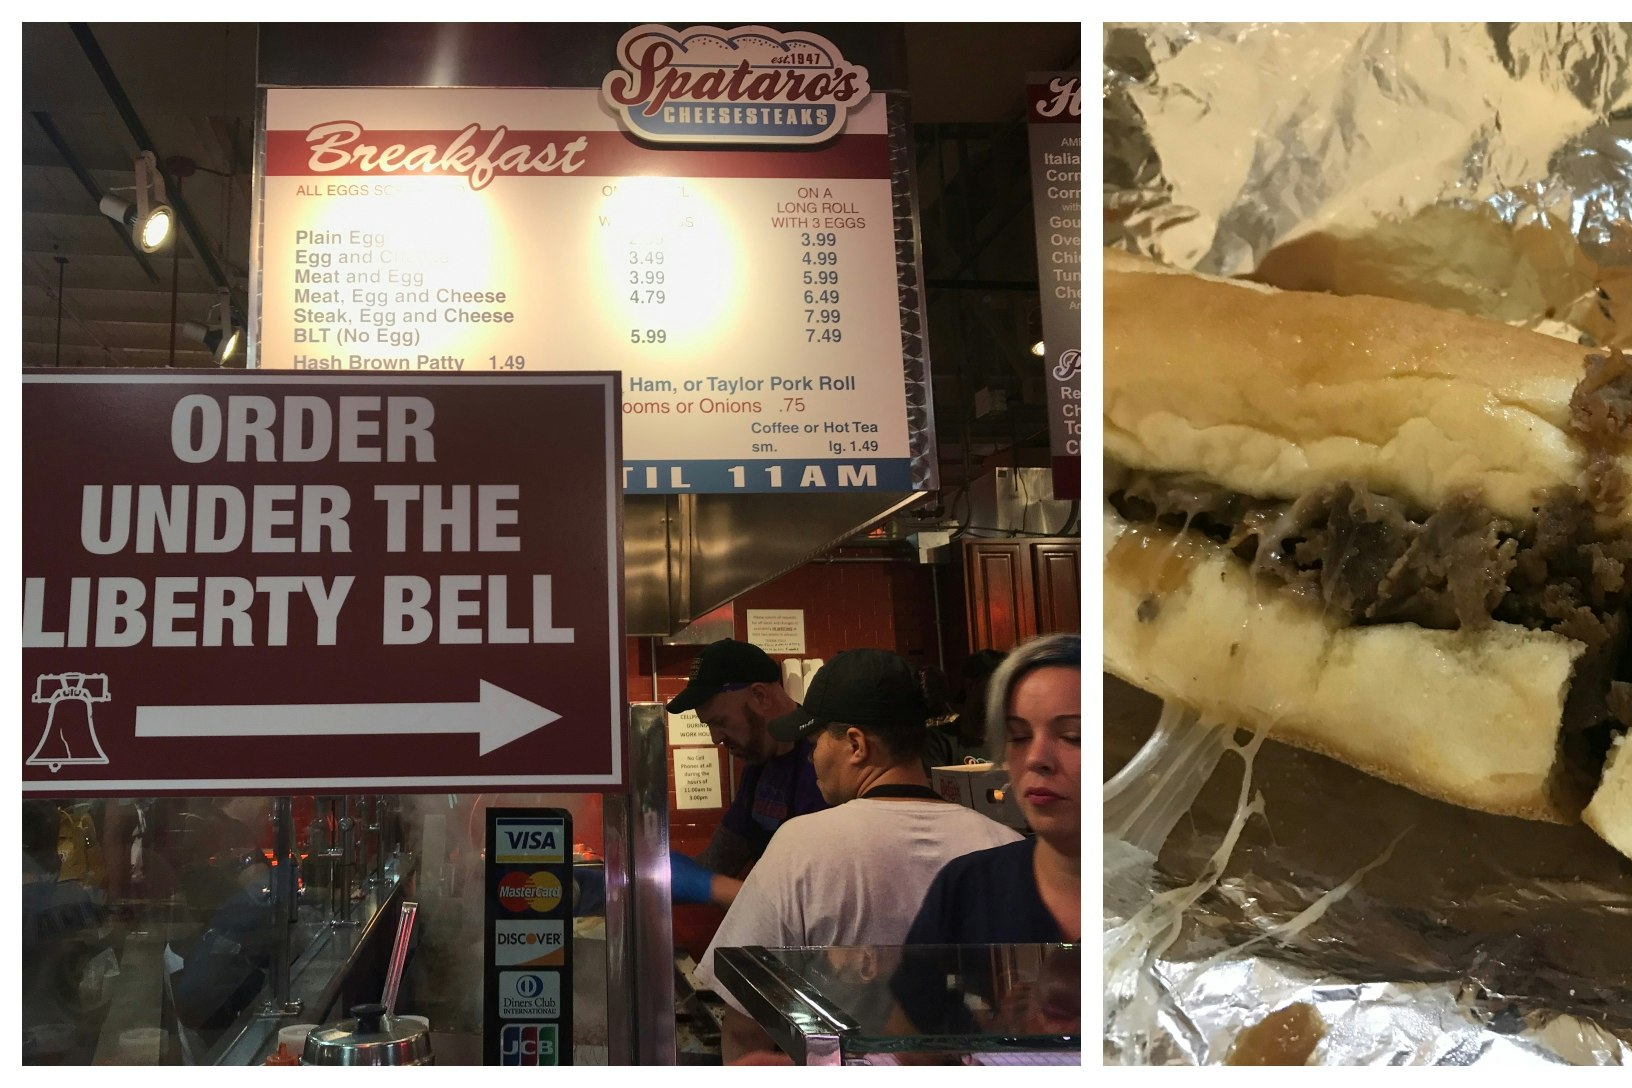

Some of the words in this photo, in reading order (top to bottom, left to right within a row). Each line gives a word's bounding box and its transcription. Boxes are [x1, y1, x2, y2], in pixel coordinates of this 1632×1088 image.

[610, 31, 859, 116] Spataro's
[663, 106, 829, 125] CHEESESTEAKS
[305, 120, 588, 190] Breakfast
[296, 185, 322, 196] ALL
[327, 185, 369, 196] EGGS
[797, 188, 818, 199] ON
[823, 188, 832, 199] A
[777, 203, 817, 214] LONG
[822, 203, 859, 214] ROLL
[771, 217, 810, 229] WITH
[812, 217, 821, 229] 3
[825, 217, 866, 229] EGGS
[295, 231, 342, 245] Plain
[349, 231, 385, 248] Egg
[801, 232, 836, 246] 3.99
[295, 250, 331, 267] Egg
[338, 250, 372, 264] and
[629, 251, 664, 265] 3.49
[802, 252, 837, 266] 4.99
[1052, 251, 1081, 264] Chi
[295, 269, 339, 284] Meat
[346, 270, 380, 284] and
[388, 270, 424, 287] Egg
[629, 270, 665, 285] 3.99
[803, 271, 838, 285] 5.99
[294, 289, 345, 305] Meat,
[352, 289, 388, 306] Egg
[394, 289, 429, 303] and
[436, 289, 507, 303] Cheese
[630, 290, 665, 304] 4.79
[804, 290, 839, 304] 6.49
[294, 308, 352, 324] Steak,
[360, 308, 396, 326] Egg
[403, 308, 437, 323] and
[444, 308, 514, 323] Cheese
[805, 309, 841, 323] 7.99
[294, 328, 330, 343] BLT
[337, 328, 369, 346] (No
[377, 328, 420, 346] Egg)
[630, 329, 667, 343] 5.99
[806, 329, 842, 343] 7.49
[293, 355, 342, 370] Hash
[349, 355, 410, 370] Brown
[417, 355, 464, 371] Patty
[488, 355, 525, 370] 1.49
[630, 377, 677, 394] Ham,
[683, 379, 703, 391] or
[707, 376, 764, 395] Taylor
[771, 376, 813, 391] Pork
[819, 376, 855, 390] Roll
[676, 401, 693, 413] or
[699, 398, 762, 413] Onions
[779, 398, 806, 413] .75
[171, 394, 437, 464] ORDER
[751, 422, 799, 434] Coffee
[804, 424, 819, 433] or
[824, 422, 850, 433] Hot
[852, 422, 878, 433] Tea
[752, 442, 778, 453] sm.
[829, 441, 846, 455] lg.
[850, 441, 879, 452] 1.49
[1066, 440, 1081, 455] C
[81, 484, 352, 555] UNDER
[374, 484, 521, 553] THE
[22, 575, 356, 648] LIBERTY
[383, 574, 575, 646] BELL
[504, 831, 556, 850] VISA
[499, 885, 561, 898] MasterCard
[498, 932, 561, 945] DISCOVER
[503, 998, 533, 1008] Diners
[535, 997, 556, 1008] Club
[503, 1040, 554, 1055] JCB
